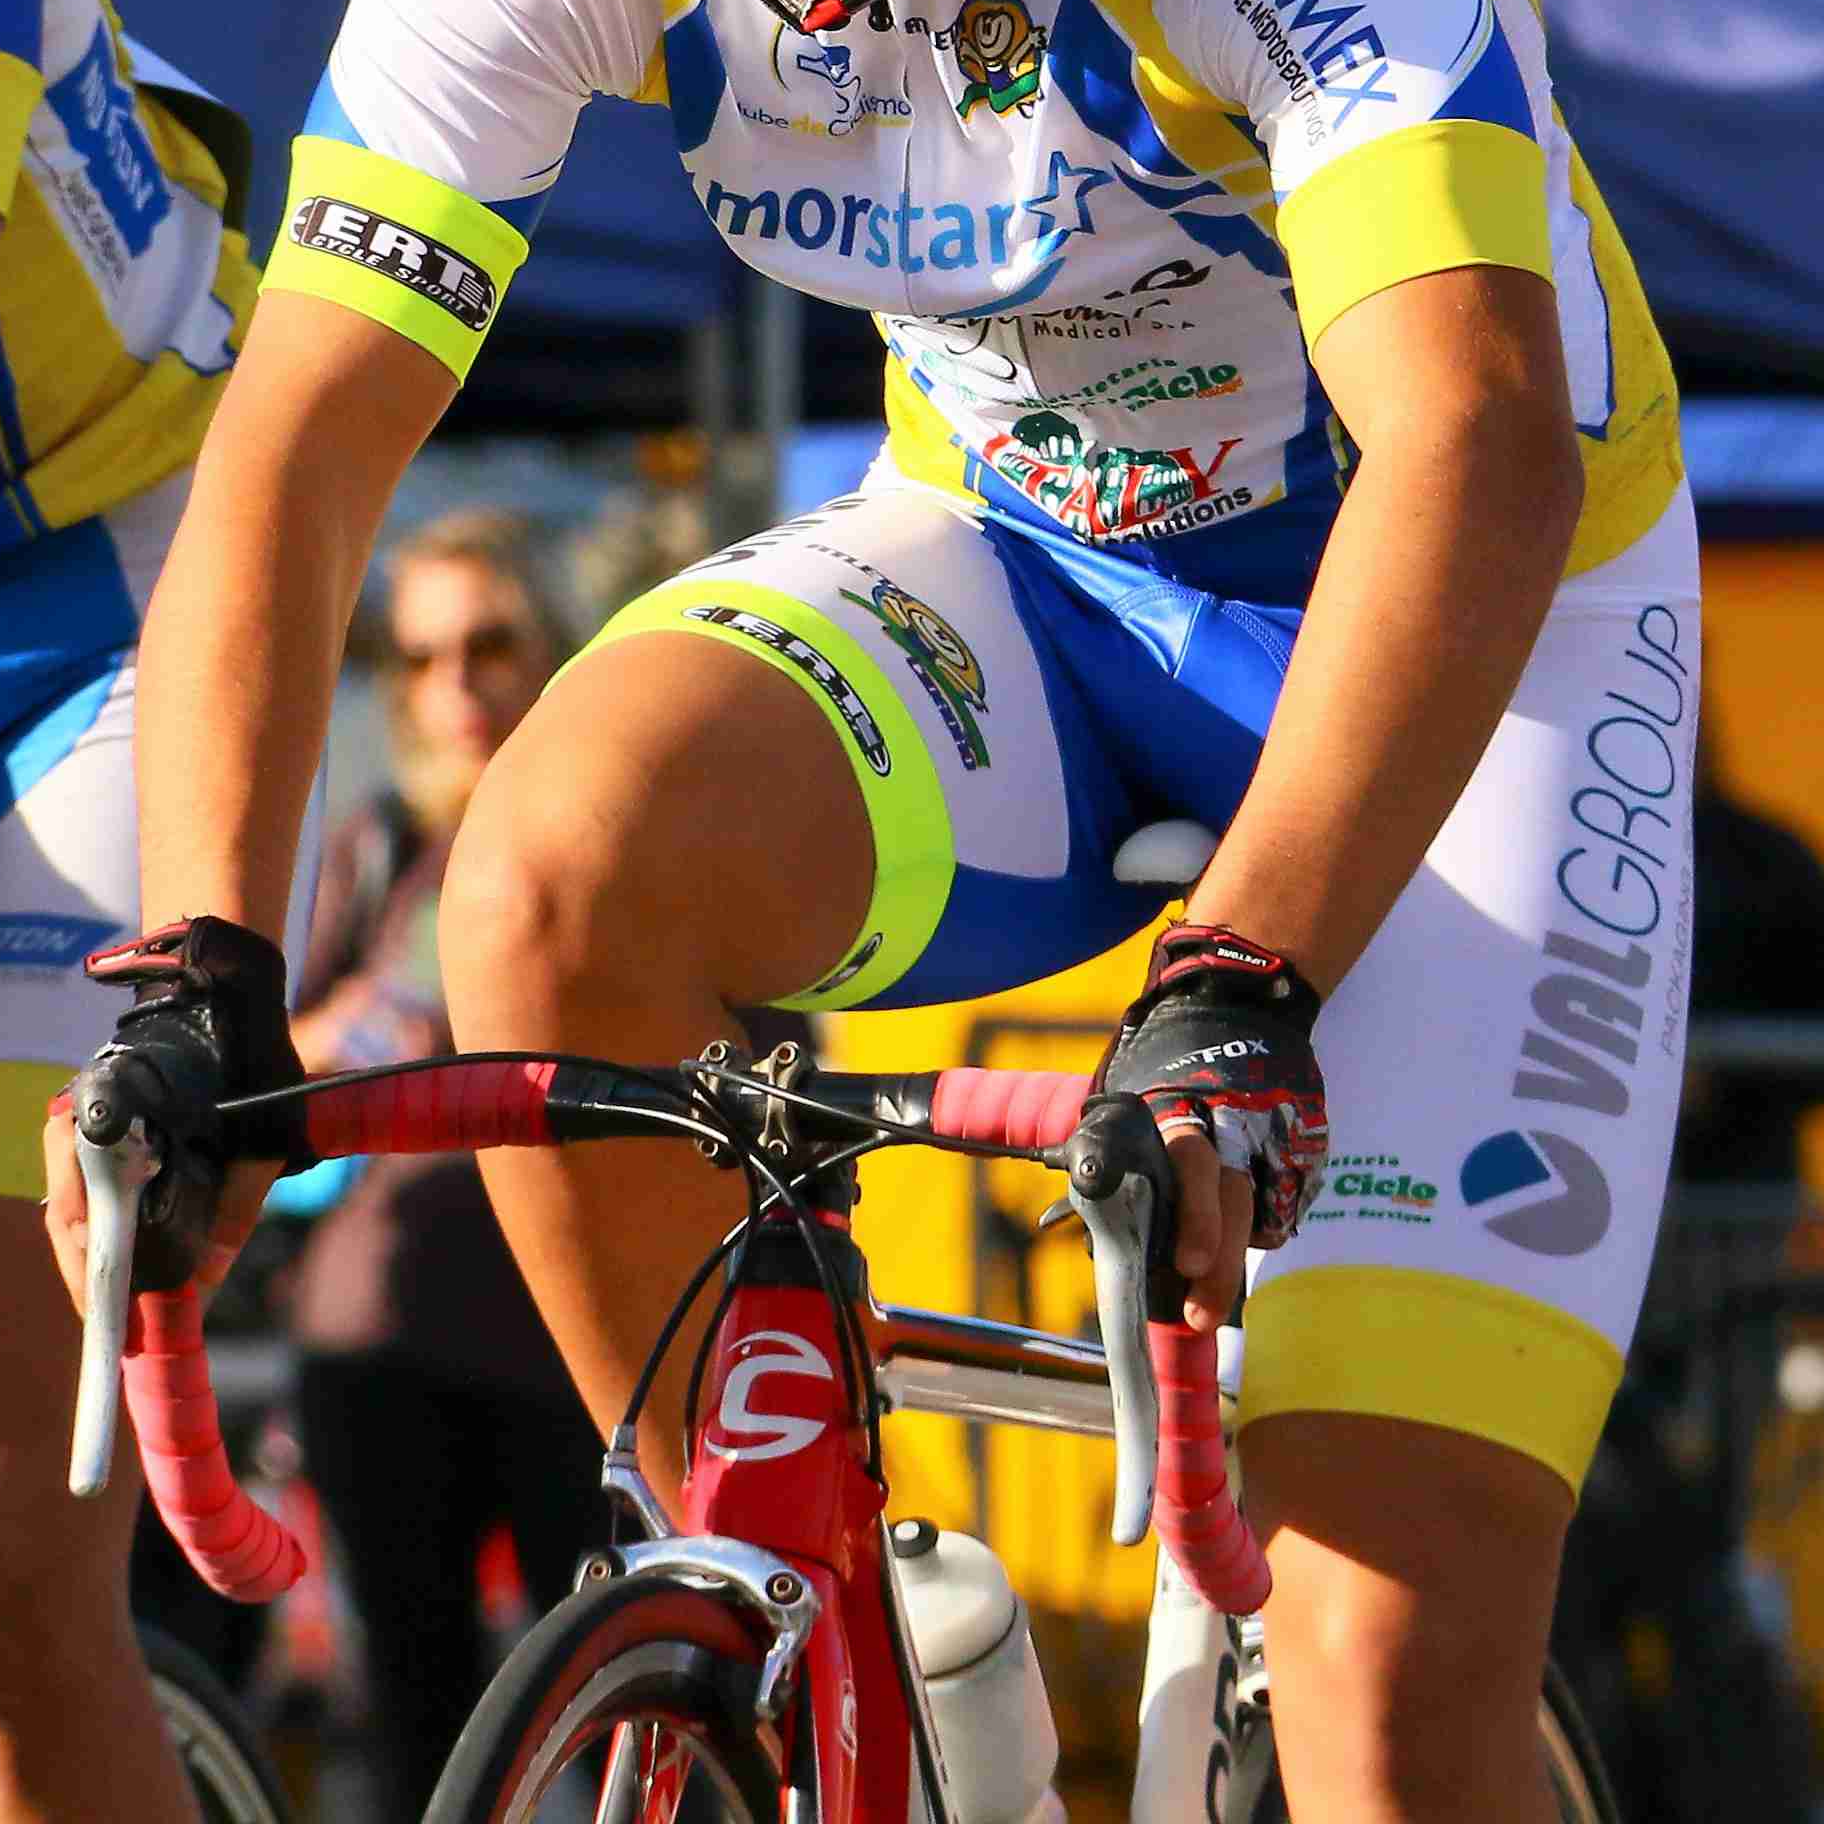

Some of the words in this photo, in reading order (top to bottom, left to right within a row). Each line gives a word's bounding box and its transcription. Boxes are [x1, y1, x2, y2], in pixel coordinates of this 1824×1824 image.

[318, 203, 486, 306] ERT
[705, 179, 1018, 275] morstar
[310, 234, 385, 268] CYCLE
[393, 266, 469, 313] SPORT
[1032, 319, 1133, 340] Medical
[1511, 604, 1688, 1118] VALGROUP
[1333, 1172, 1438, 1200] Ciclo
